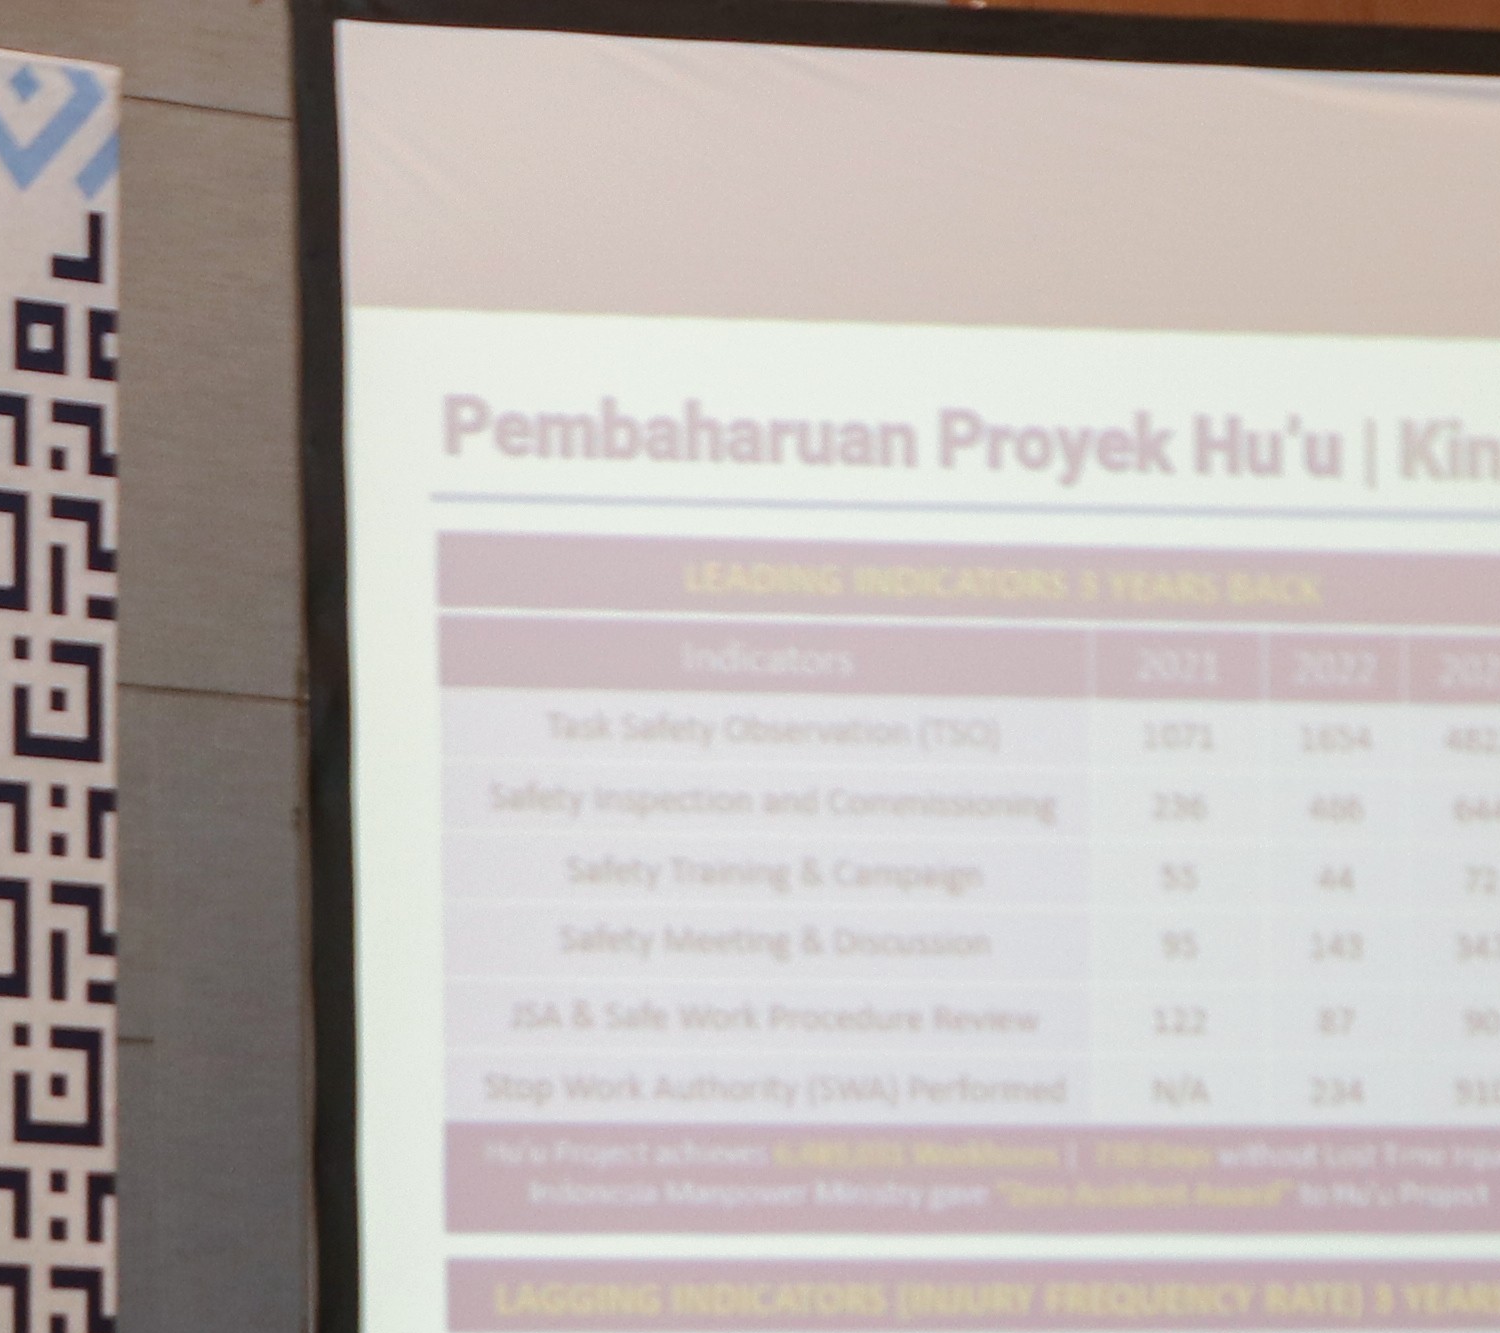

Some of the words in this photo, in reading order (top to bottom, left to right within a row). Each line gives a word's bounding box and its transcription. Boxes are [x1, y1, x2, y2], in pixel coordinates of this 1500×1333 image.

[443, 395, 917, 468] Pembaharuan
[938, 407, 1174, 487] Proyek
[1195, 413, 1342, 478] Hu'u
[680, 640, 856, 676] Indicators
[547, 710, 610, 742] Task
[622, 712, 714, 748] Safety
[724, 714, 910, 746] Observation
[490, 780, 585, 819] Safety
[594, 783, 754, 819] Inspection
[762, 785, 819, 814] and
[564, 854, 661, 891] Safety
[669, 856, 792, 894] Training
[831, 857, 984, 896] Campaign
[557, 922, 656, 961] Safety
[662, 925, 792, 962] Meeting
[832, 926, 993, 957] Discussion
[604, 998, 669, 1031] Safe
[677, 1000, 759, 1031] Work
[767, 1001, 923, 1032] Procedure
[931, 1003, 1040, 1033] Review
[482, 1070, 554, 1106] Stop
[561, 1071, 643, 1102] Work
[652, 1071, 799, 1107] Authority
[907, 1073, 1067, 1103] Performed
[493, 1282, 661, 1317] LAGGING
[671, 1282, 886, 1317] INDICATORS
[1044, 1281, 1255, 1319] FREQUENCY
